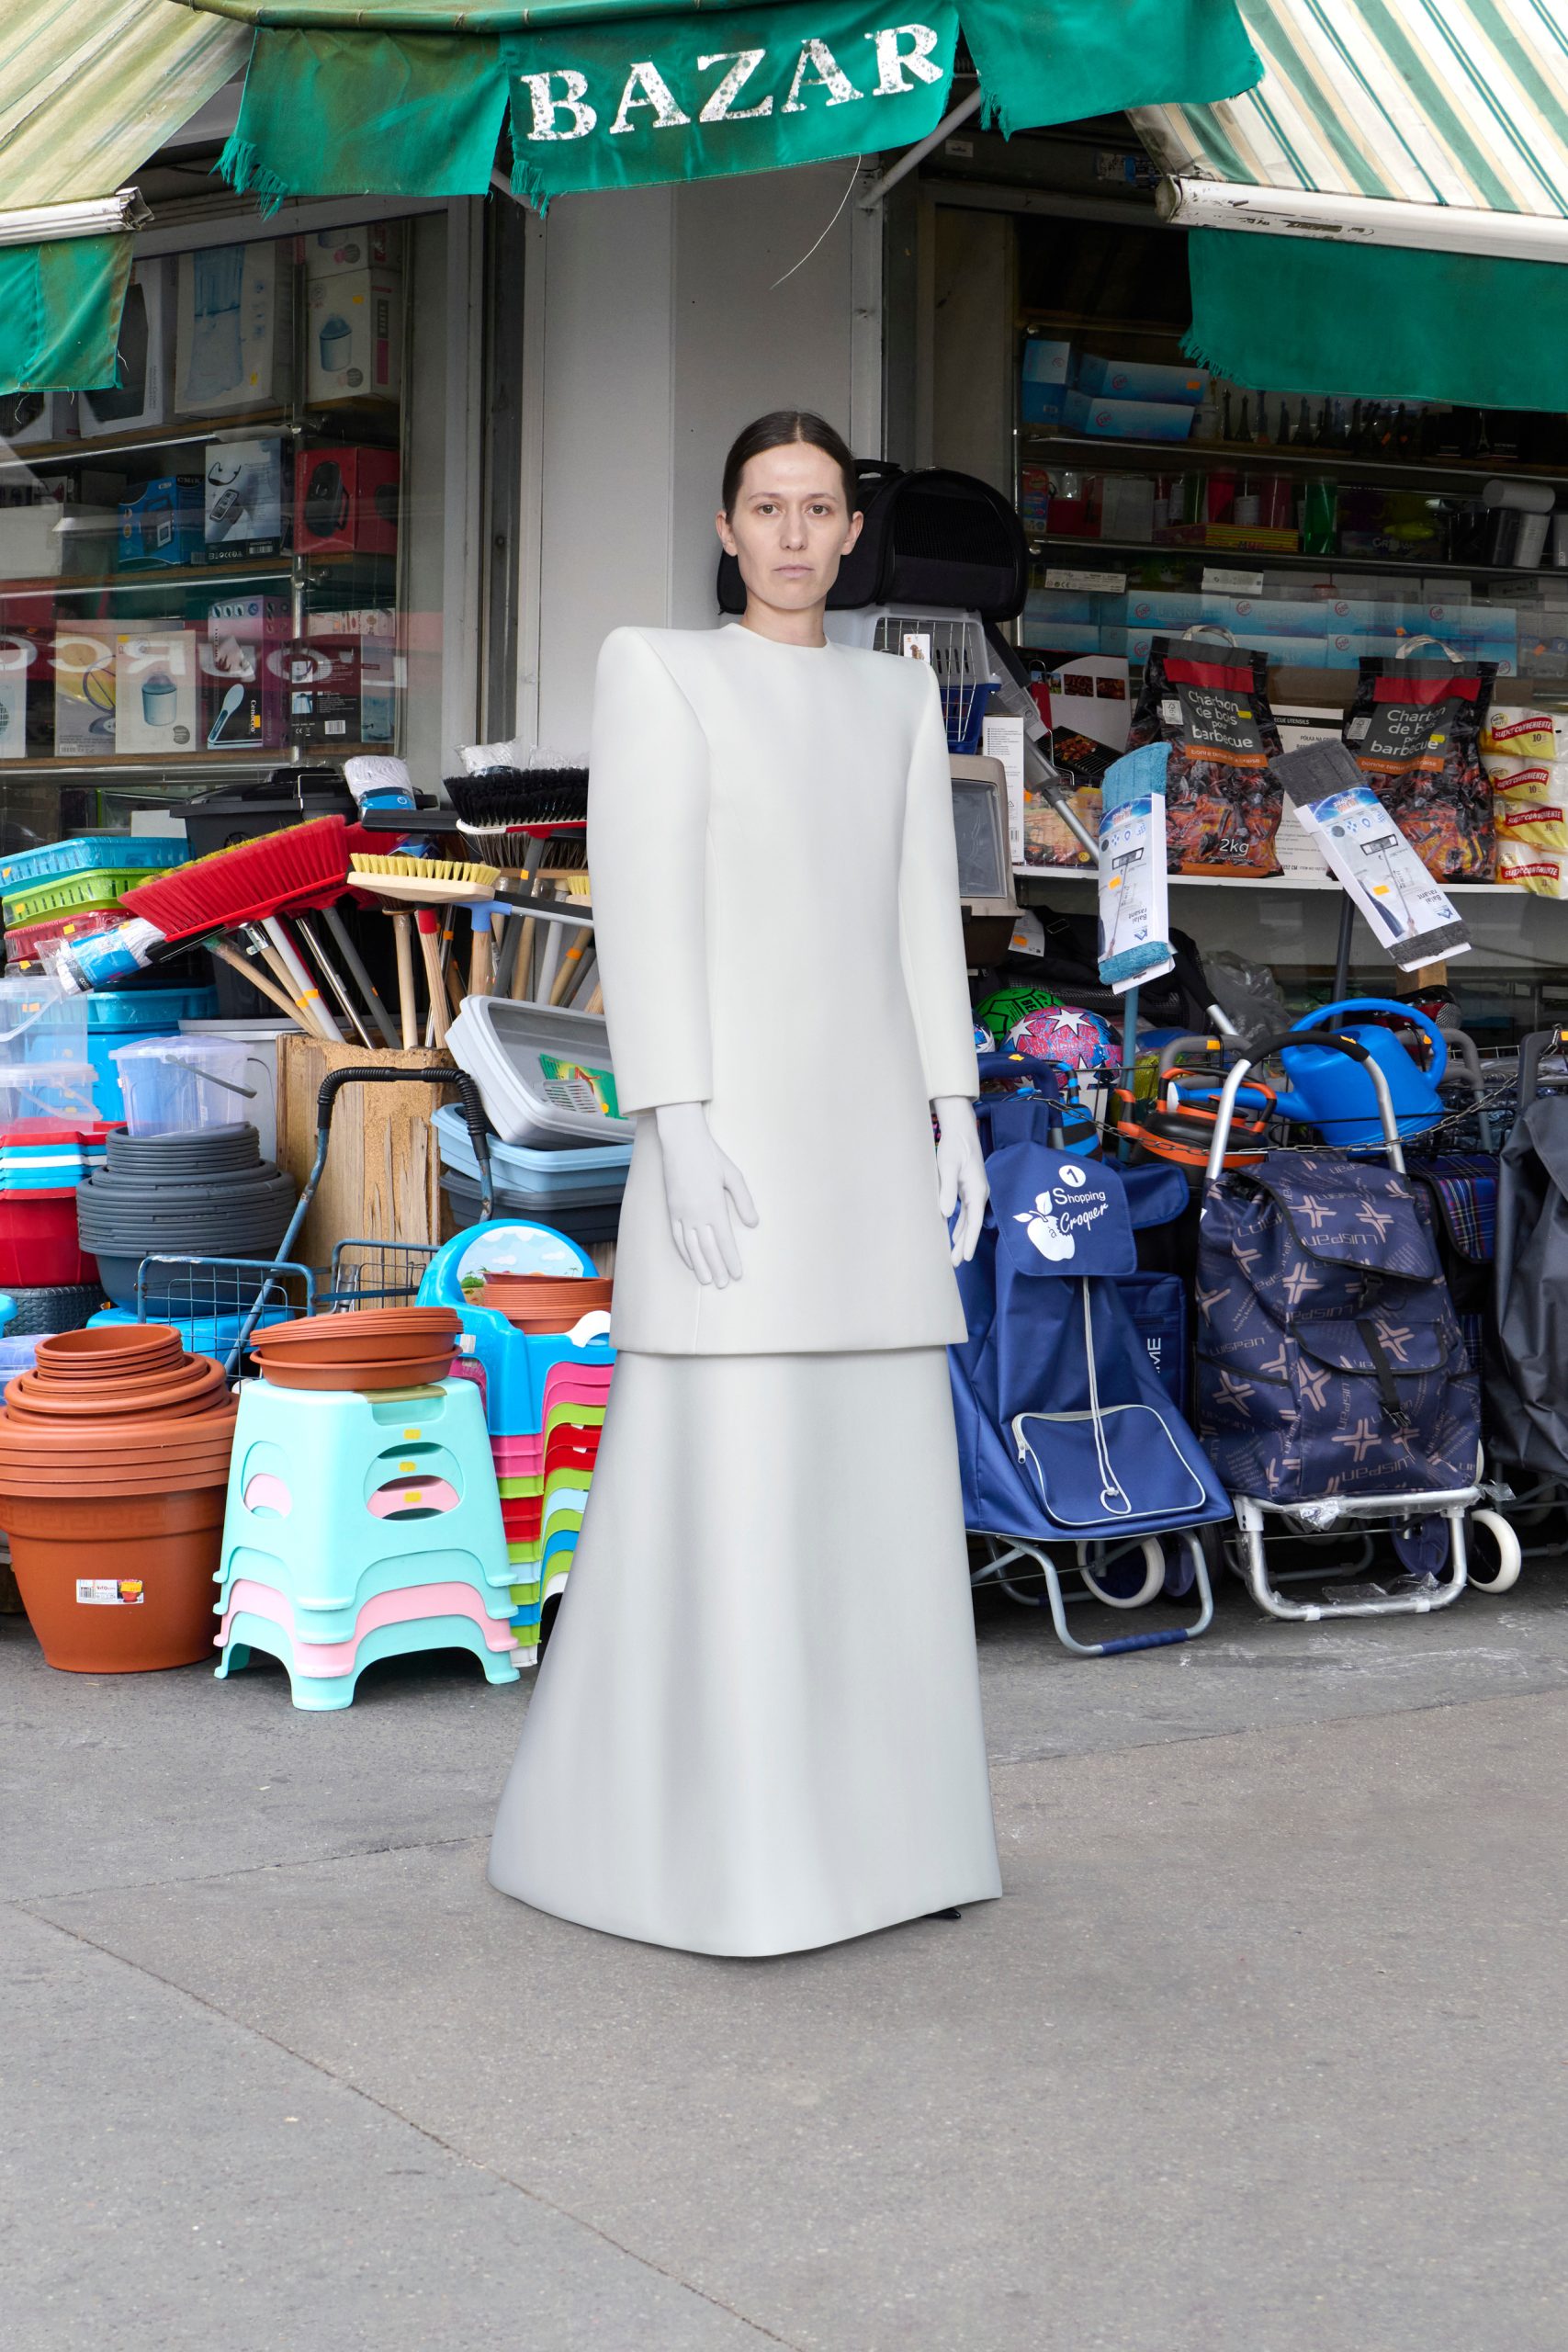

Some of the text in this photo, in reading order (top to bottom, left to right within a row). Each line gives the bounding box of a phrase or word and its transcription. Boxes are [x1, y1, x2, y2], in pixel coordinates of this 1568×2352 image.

[519, 23, 945, 141] BAZAR
[1188, 690, 1239, 712] Charbon
[1195, 706, 1212, 718] de
[1214, 708, 1237, 726] bois
[1212, 720, 1227, 730] pour
[1388, 723, 1409, 735] de
[1191, 724, 1253, 748] barbecue
[1532, 733, 1541, 742] 10
[1529, 785, 1537, 794] 10
[1219, 838, 1249, 856] 2kg
[1426, 894, 1442, 904] Balai
[1132, 913, 1147, 924] Balai
[1021, 999, 1037, 1012] BE
[1066, 1168, 1078, 1183] 1
[1052, 1187, 1106, 1205] Shopping
[1059, 1203, 1109, 1234] Croquer
